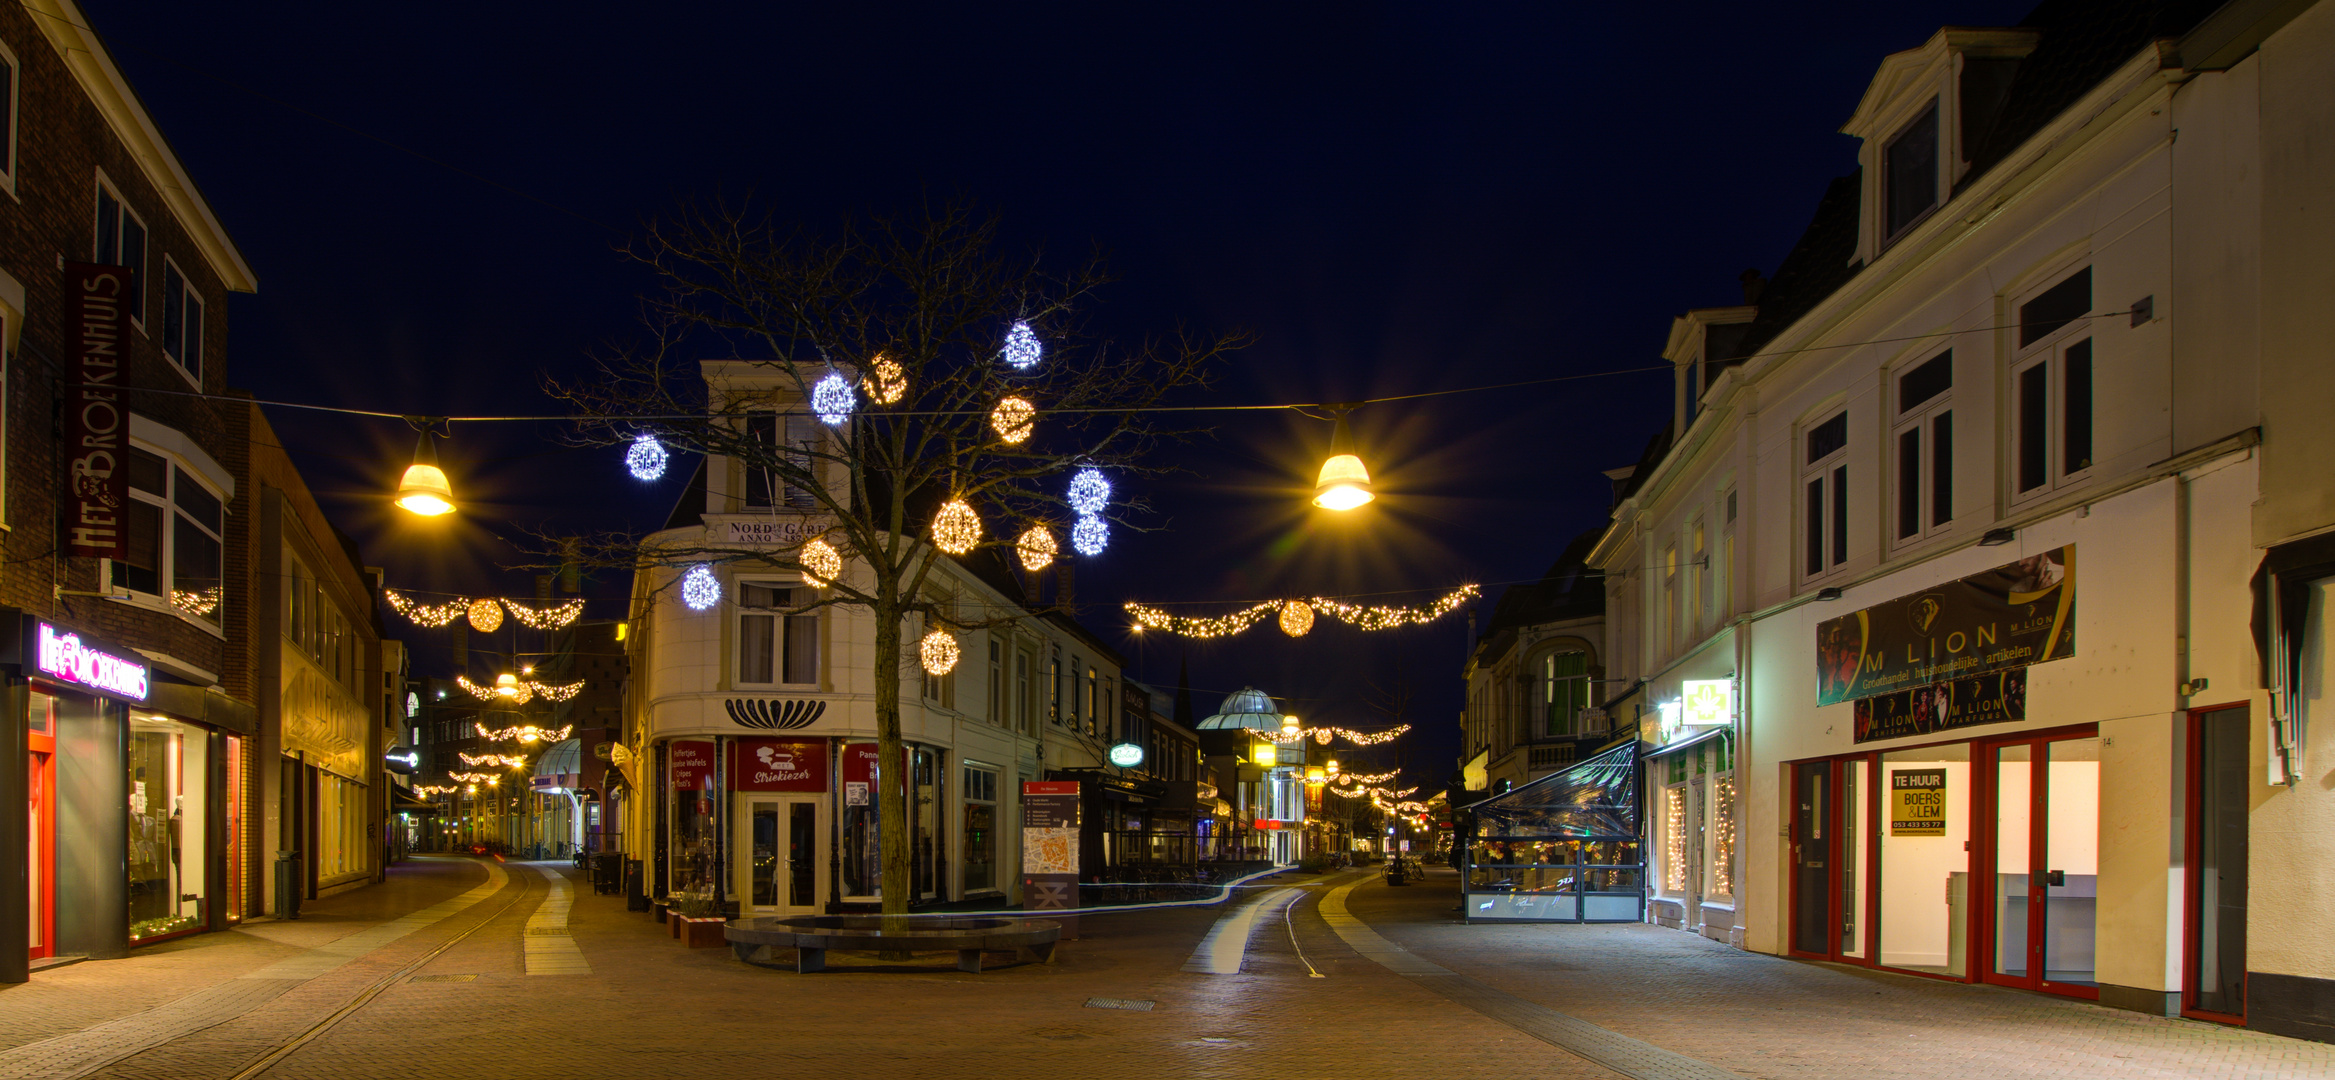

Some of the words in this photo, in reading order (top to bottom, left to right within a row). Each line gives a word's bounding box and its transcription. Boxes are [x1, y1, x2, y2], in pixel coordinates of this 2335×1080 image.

[70, 502, 117, 549] HET
[731, 522, 772, 534] NORD
[2024, 615, 2053, 629] LION
[1866, 651, 1883, 673] M
[1908, 622, 1997, 664] LION
[1863, 670, 1909, 690] Groothandel
[1915, 656, 1978, 679] huishoudelijke
[1986, 646, 2032, 664] artikelen
[1967, 699, 2001, 714] LION
[1884, 714, 1912, 728] LION
[1951, 711, 2000, 725] PARFUMS
[1874, 726, 1907, 737] SHISHA
[2103, 737, 2112, 747] 14
[686, 758, 707, 767] Wafels
[753, 768, 811, 784] Striekiezer
[1894, 775, 1908, 787] TE
[1910, 775, 1941, 787] HUUR
[1904, 793, 1941, 805] BOERS
